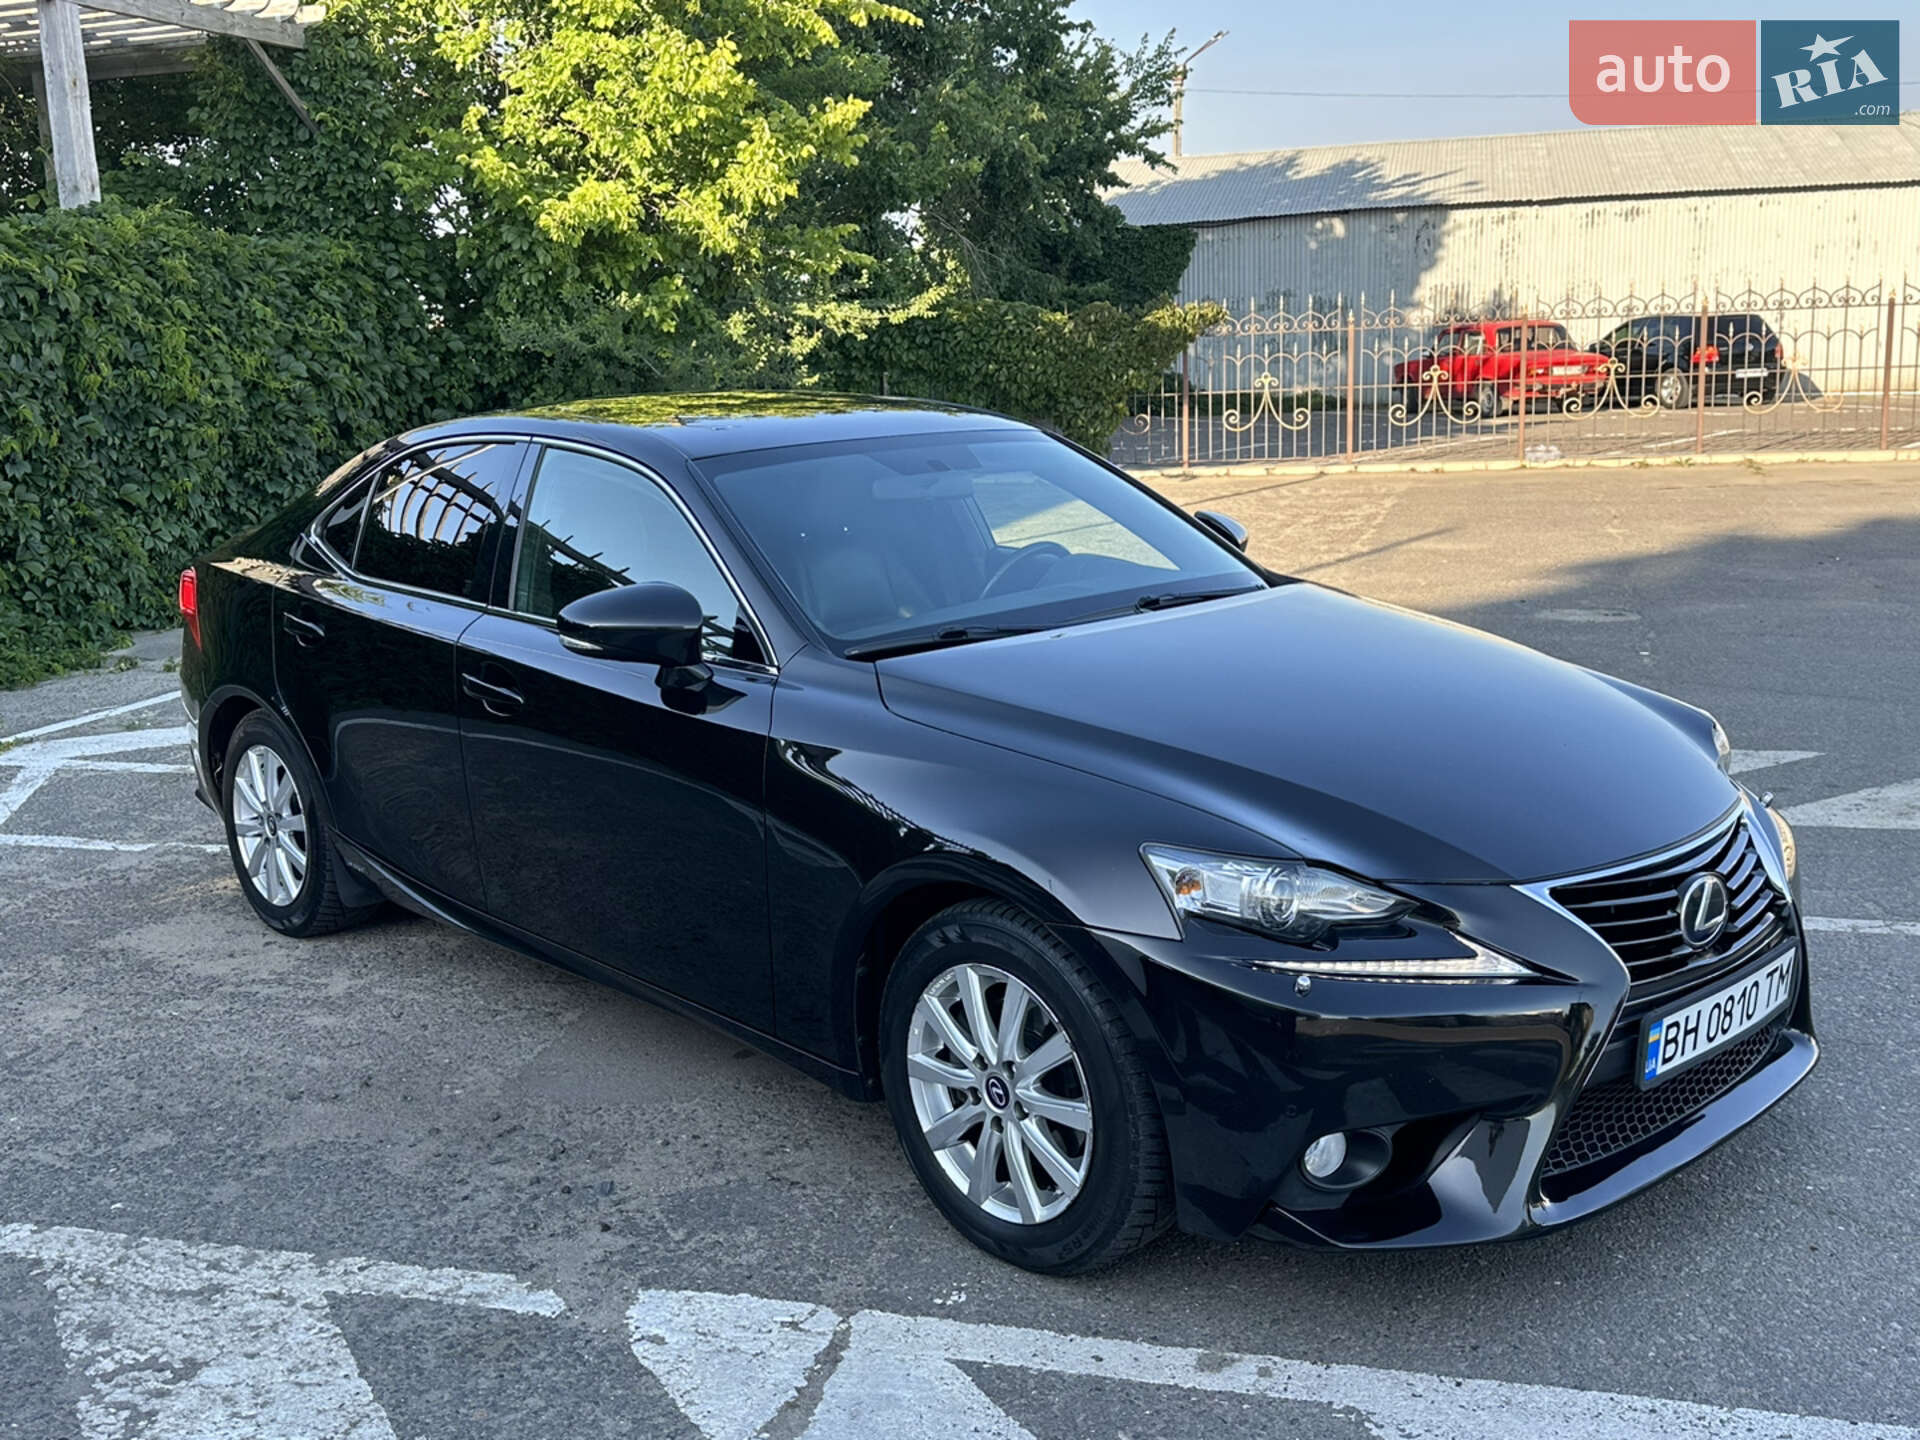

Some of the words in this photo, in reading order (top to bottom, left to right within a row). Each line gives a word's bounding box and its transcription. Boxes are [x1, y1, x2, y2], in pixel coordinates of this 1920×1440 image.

[1661, 1009, 1701, 1066] BH
[1706, 980, 1760, 1043] 0810
[1765, 956, 1794, 1009] TM
